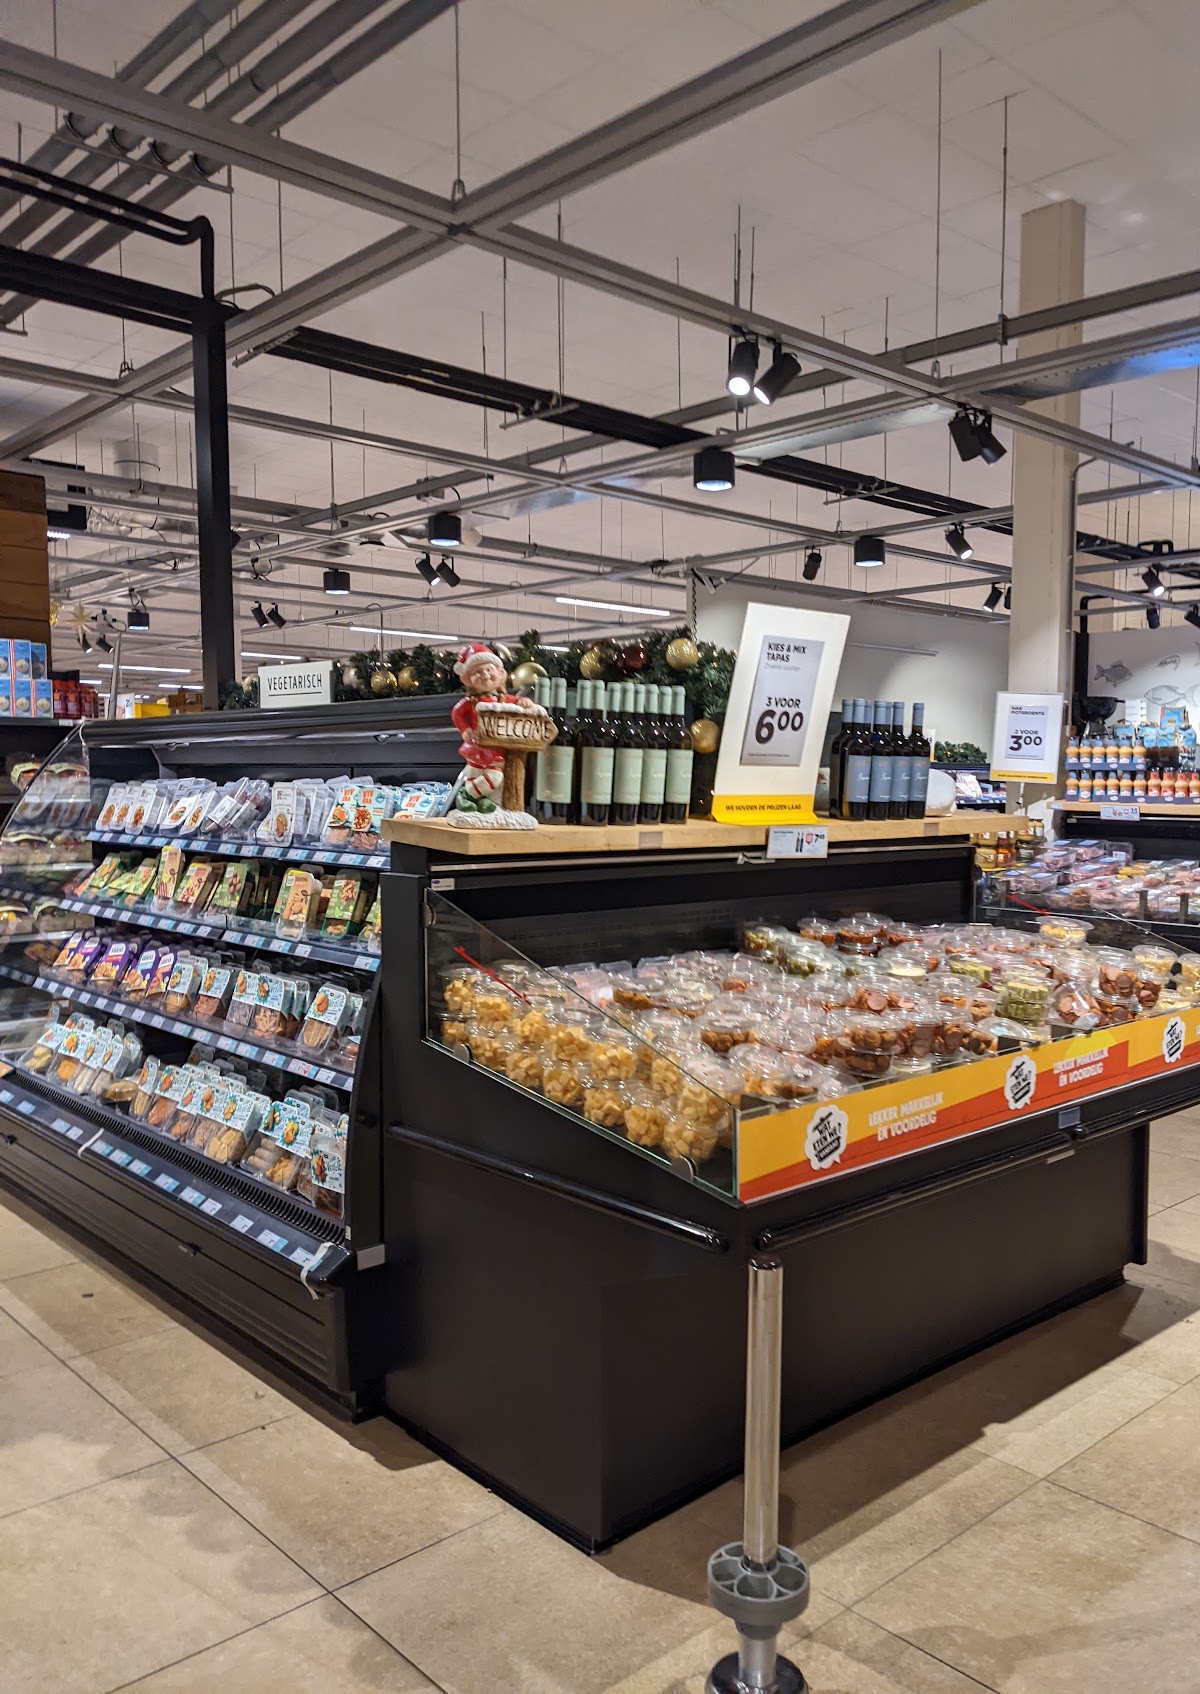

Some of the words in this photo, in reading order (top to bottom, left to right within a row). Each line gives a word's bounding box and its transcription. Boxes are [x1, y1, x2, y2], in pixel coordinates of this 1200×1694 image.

[767, 642, 785, 653] KIES
[786, 644, 791, 653] &
[793, 645, 807, 655] MIX
[766, 652, 790, 663] TAPAS
[267, 673, 322, 691] VEGETARISCH
[766, 696, 772, 707] 3
[774, 698, 801, 709] VOOR
[480, 715, 553, 739] WELCOME
[725, 804, 734, 812] WE
[736, 804, 758, 812] HOUDEN
[868, 1106, 898, 1128] LEKKER
[890, 1109, 937, 1137] VOORDELIG
